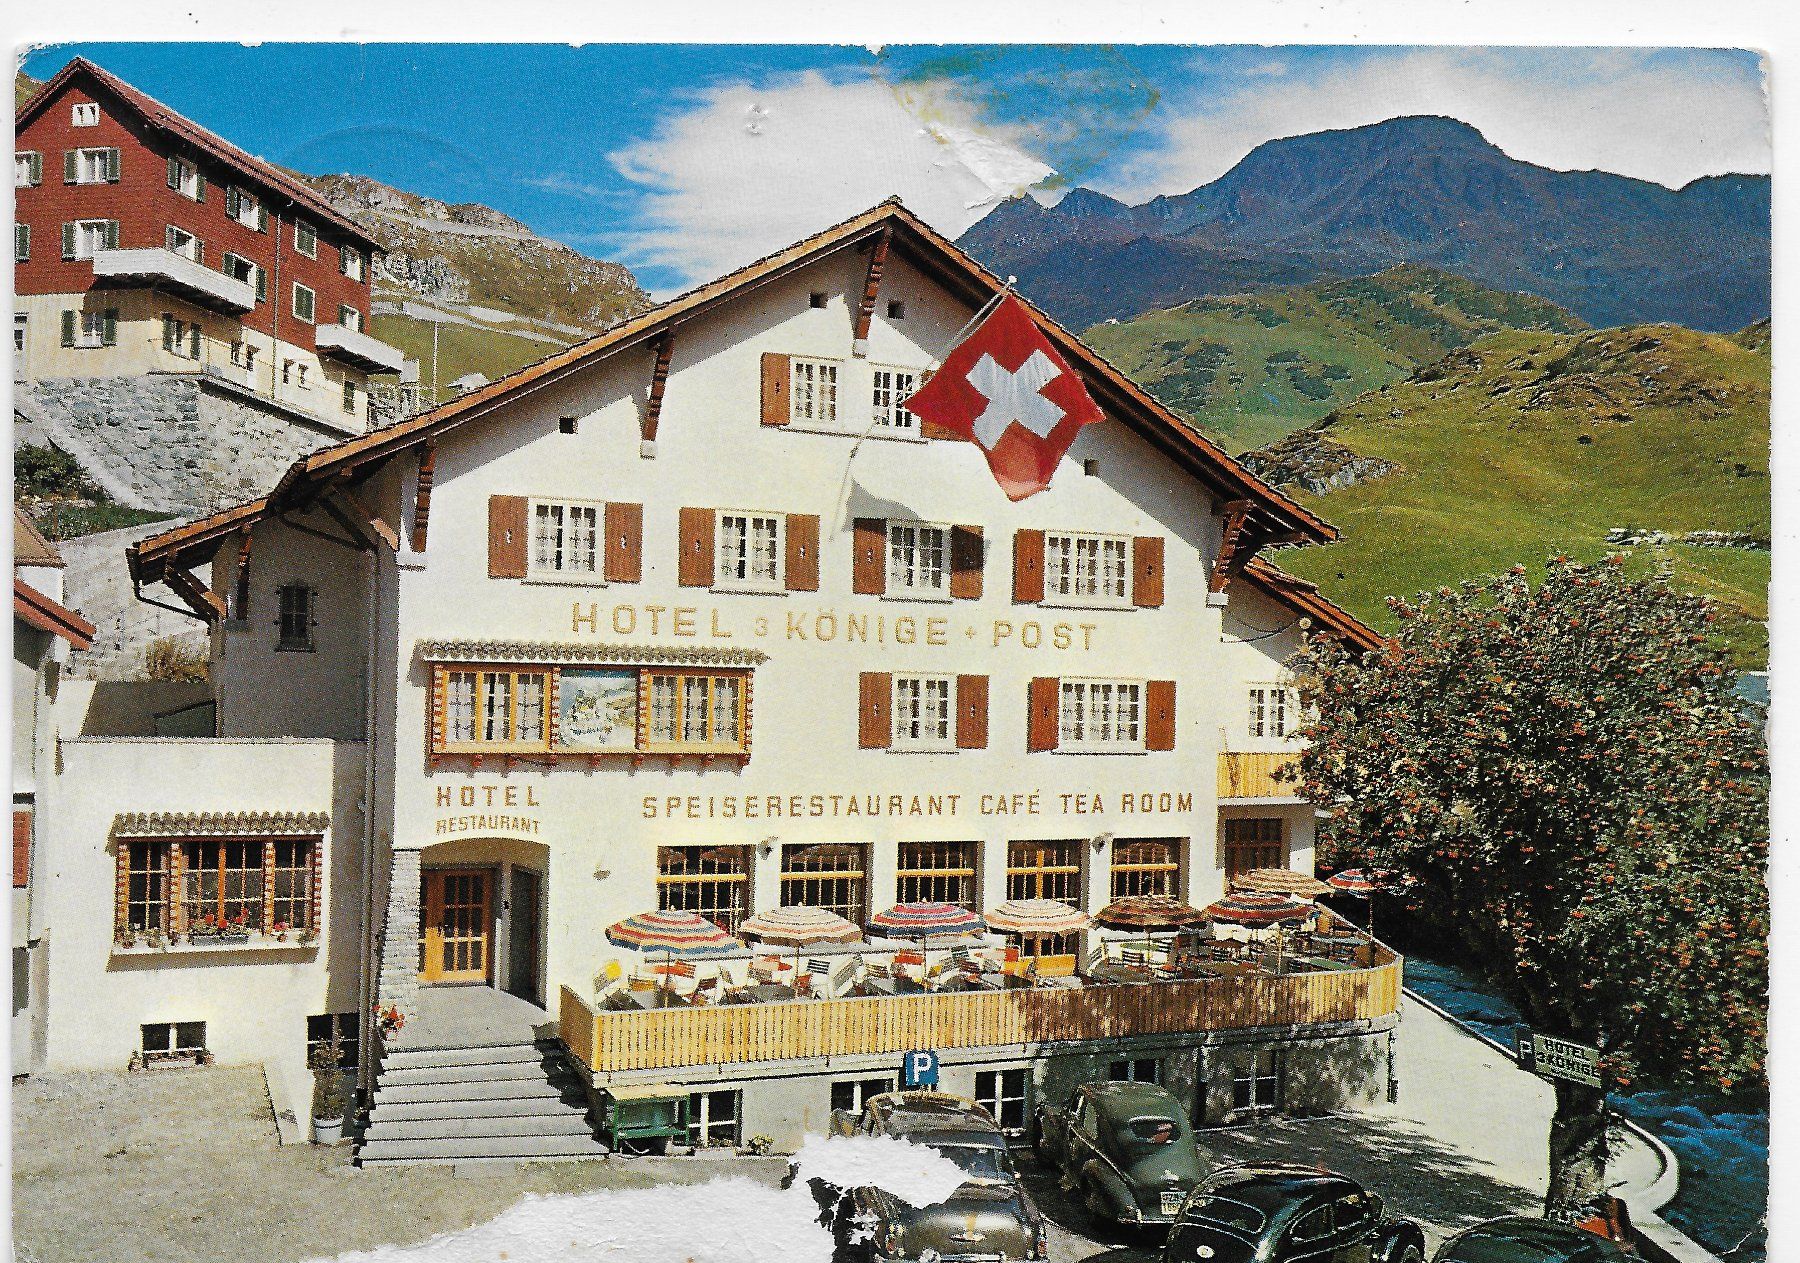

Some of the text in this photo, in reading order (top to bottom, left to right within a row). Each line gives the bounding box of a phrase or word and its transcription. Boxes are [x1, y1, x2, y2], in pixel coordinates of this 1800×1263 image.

[572, 602, 733, 639] HOTEL
[755, 617, 768, 637] 3
[786, 608, 948, 648] KÖNIGE
[993, 619, 1098, 651] POST
[436, 785, 540, 808] HOTEL
[643, 788, 1194, 819] SPEISERESTAURANT CAFÉ TEA ROOM
[436, 814, 540, 837] RESTAURANT
[1536, 1051, 1546, 1064] 3
[1544, 1040, 1591, 1061] HOTEL
[913, 1053, 931, 1082] P
